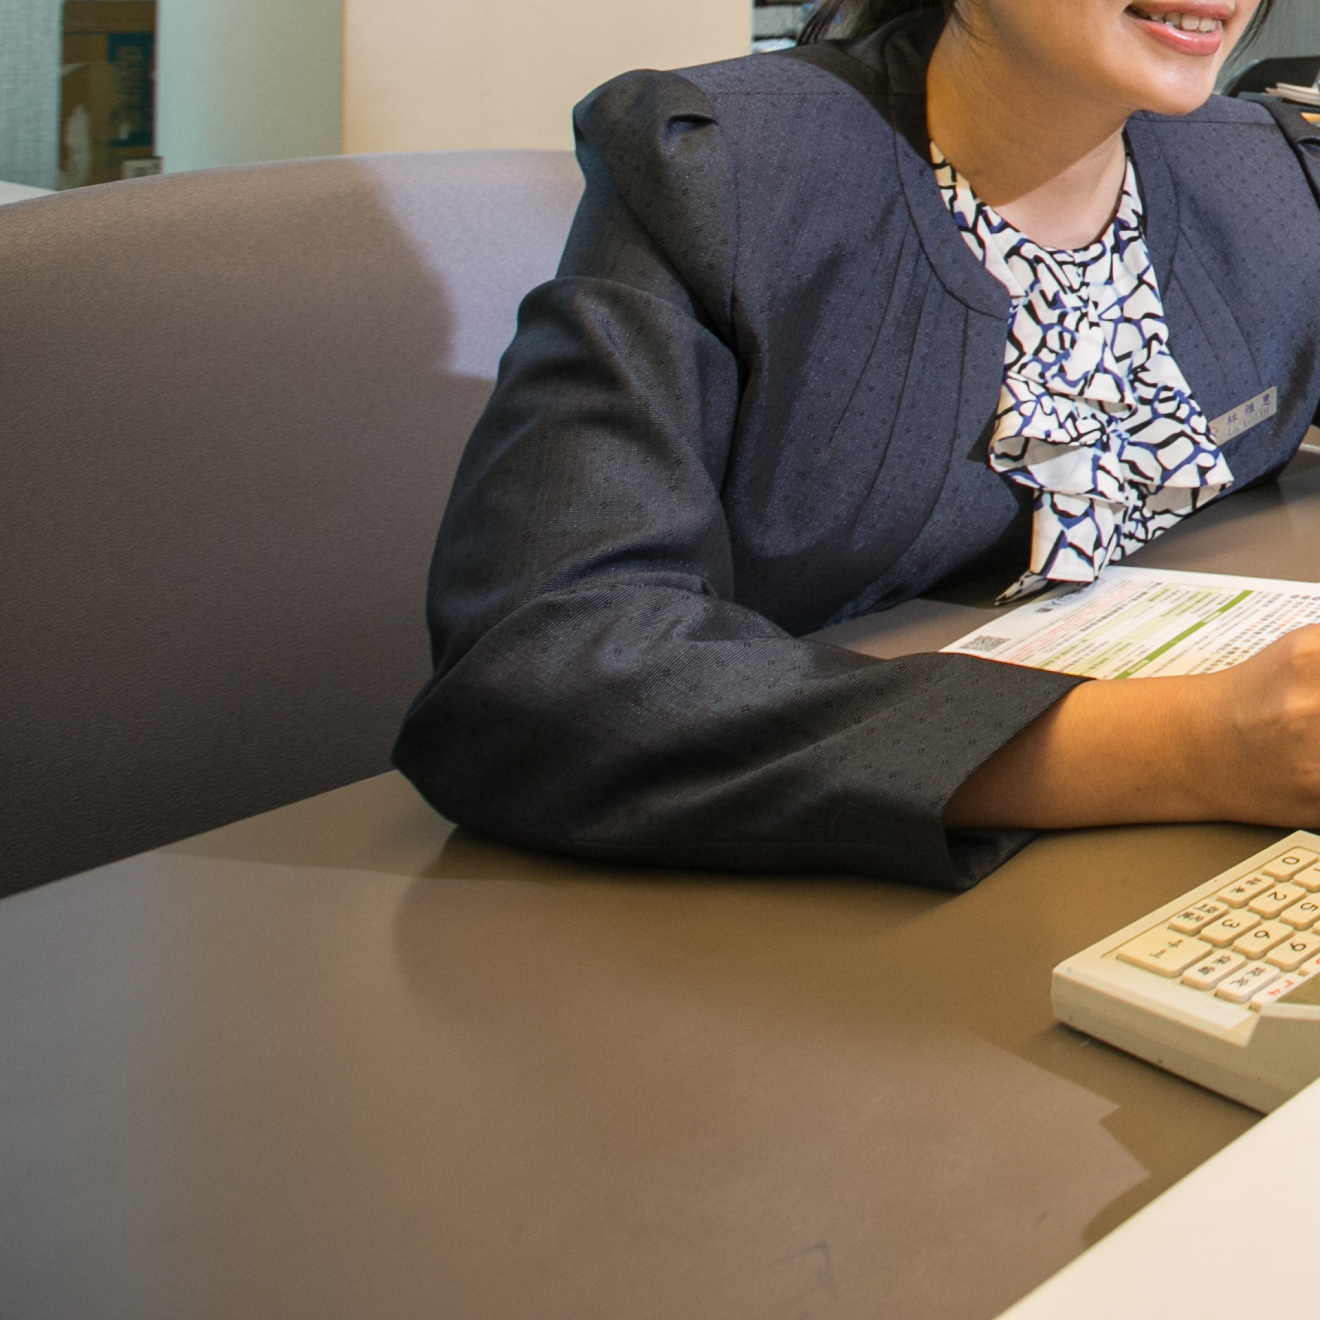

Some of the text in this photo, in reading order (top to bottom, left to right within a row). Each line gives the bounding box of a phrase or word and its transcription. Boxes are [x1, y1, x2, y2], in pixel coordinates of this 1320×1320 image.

[1282, 855, 1300, 866] 0
[1267, 890, 1288, 901] 2
[1299, 902, 1319, 912] 5
[1221, 918, 1241, 929] 3
[1254, 929, 1271, 940] 6
[1290, 941, 1306, 952] 9
